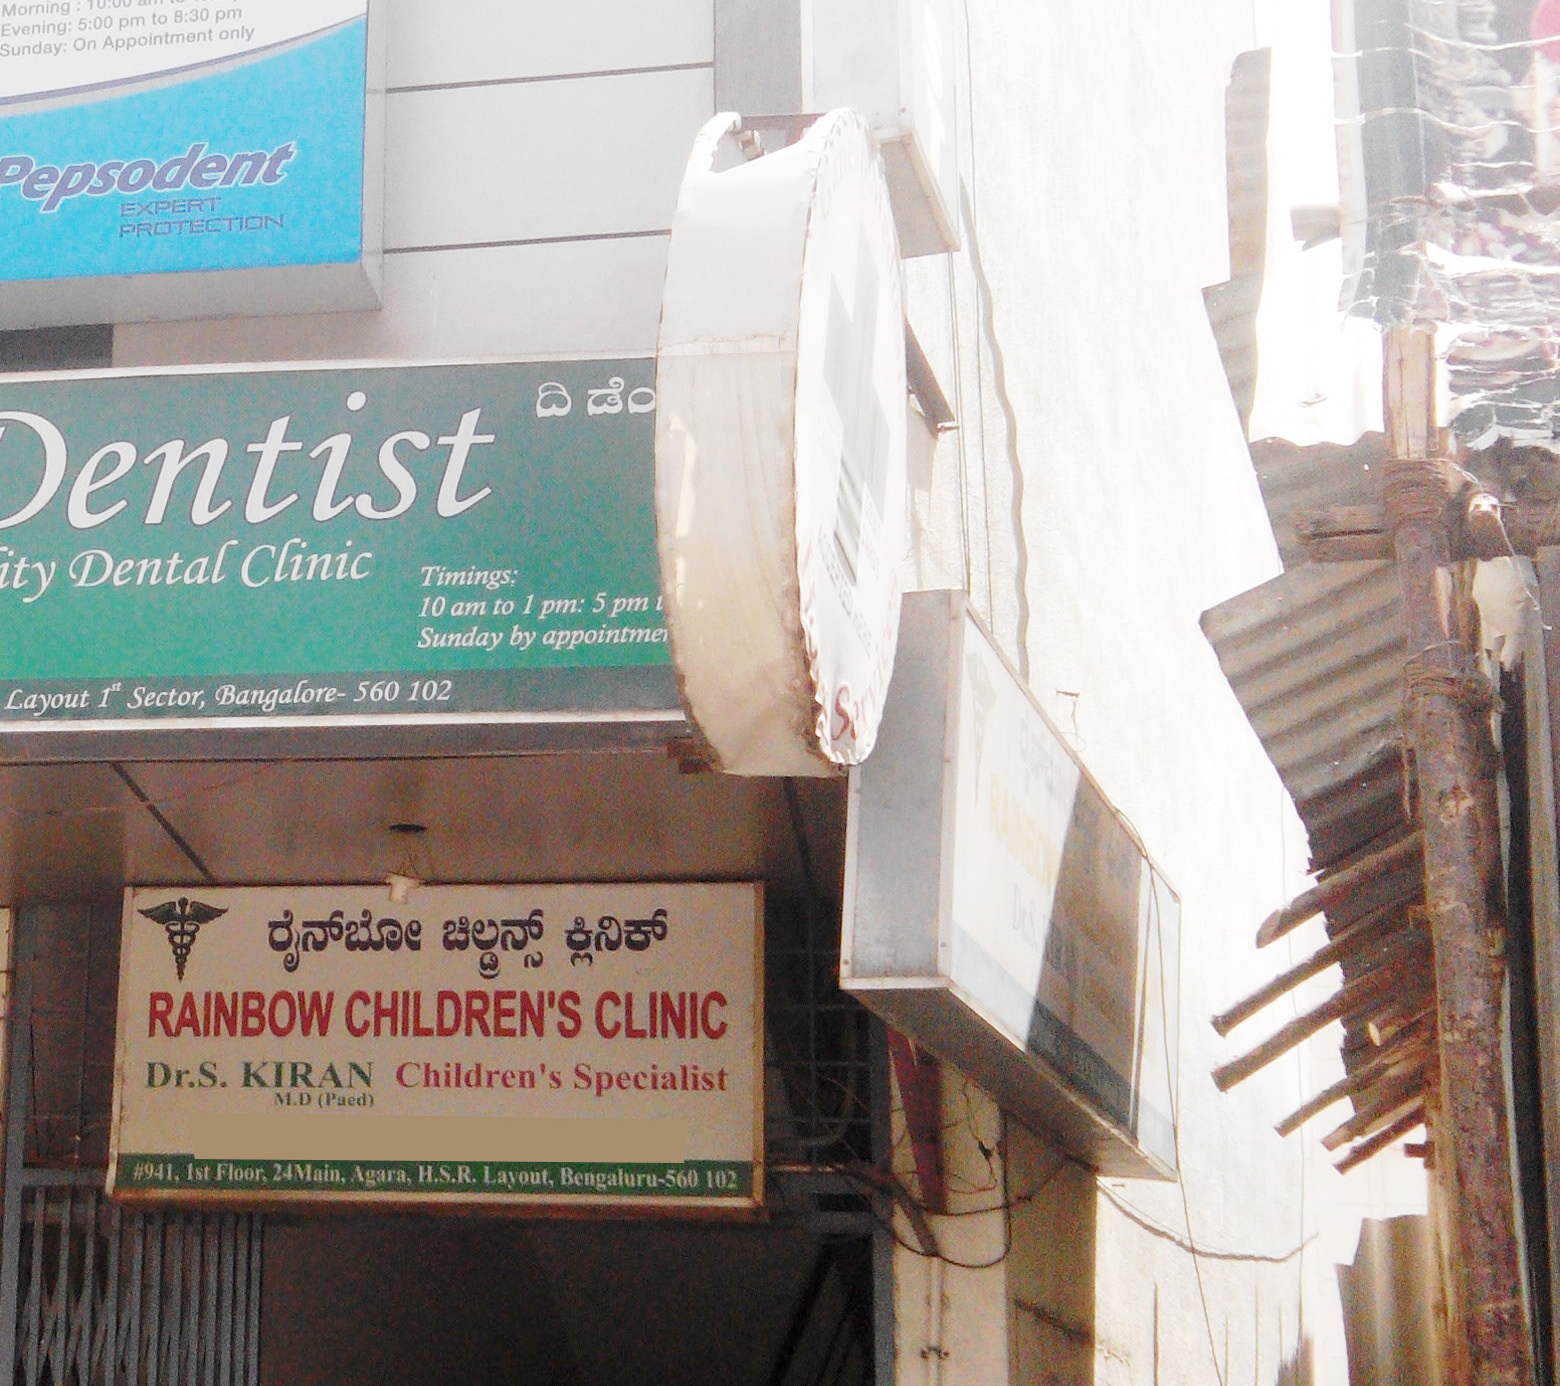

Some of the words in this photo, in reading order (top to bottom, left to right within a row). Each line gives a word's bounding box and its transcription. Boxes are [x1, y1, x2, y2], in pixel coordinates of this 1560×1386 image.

[0, 20, 72, 38] Evening:
[78, 15, 113, 31] 5:00
[118, 17, 146, 32] pm
[151, 12, 168, 26] to
[173, 8, 210, 24] 8:30
[215, 7, 242, 24] pm
[1, 0, 70, 19] Morning
[0, 40, 68, 59] Sunday:
[73, 37, 97, 52] On
[102, 28, 214, 51] Appointment
[218, 24, 255, 42] only
[119, 196, 223, 219] EXPERT
[118, 213, 285, 239] PROTECTION
[536, 381, 572, 418] ದಿ
[68, 540, 239, 589] Dental
[240, 535, 373, 589] Clinic
[420, 565, 519, 590] Timings:
[418, 596, 446, 618] 10
[450, 600, 486, 617] am
[493, 597, 515, 616] to
[522, 594, 535, 615] 1
[538, 597, 584, 620] pm:
[592, 592, 607, 613] 5
[610, 595, 649, 619] pm
[417, 626, 503, 651] Sunday
[509, 624, 536, 651] by
[4, 687, 89, 718] Layout
[126, 685, 206, 711] Sector,
[214, 678, 346, 714] Bangalore-
[352, 679, 400, 703] 560
[407, 679, 452, 703] 102
[148, 990, 335, 1038] RAINBOW
[344, 989, 582, 1039] CHILDREN'S
[594, 989, 729, 1040] CLINIC
[145, 1061, 228, 1089] Dr.S.
[241, 1061, 375, 1089] KIRAN
[395, 1060, 563, 1090] Children's
[573, 1063, 729, 1097] Specialist
[273, 1092, 312, 1107] M.D
[318, 1091, 375, 1109] (Paed)
[132, 1162, 180, 1182] #941,
[186, 1162, 209, 1181] 1st
[215, 1162, 268, 1183] Floor,
[272, 1162, 346, 1184] 24Main,
[351, 1164, 413, 1187] Agara,
[418, 1164, 477, 1184] H.S.R.
[483, 1165, 554, 1189] Layout,
[559, 1166, 699, 1191] Bengaluru-560
[706, 1169, 738, 1190] 102
